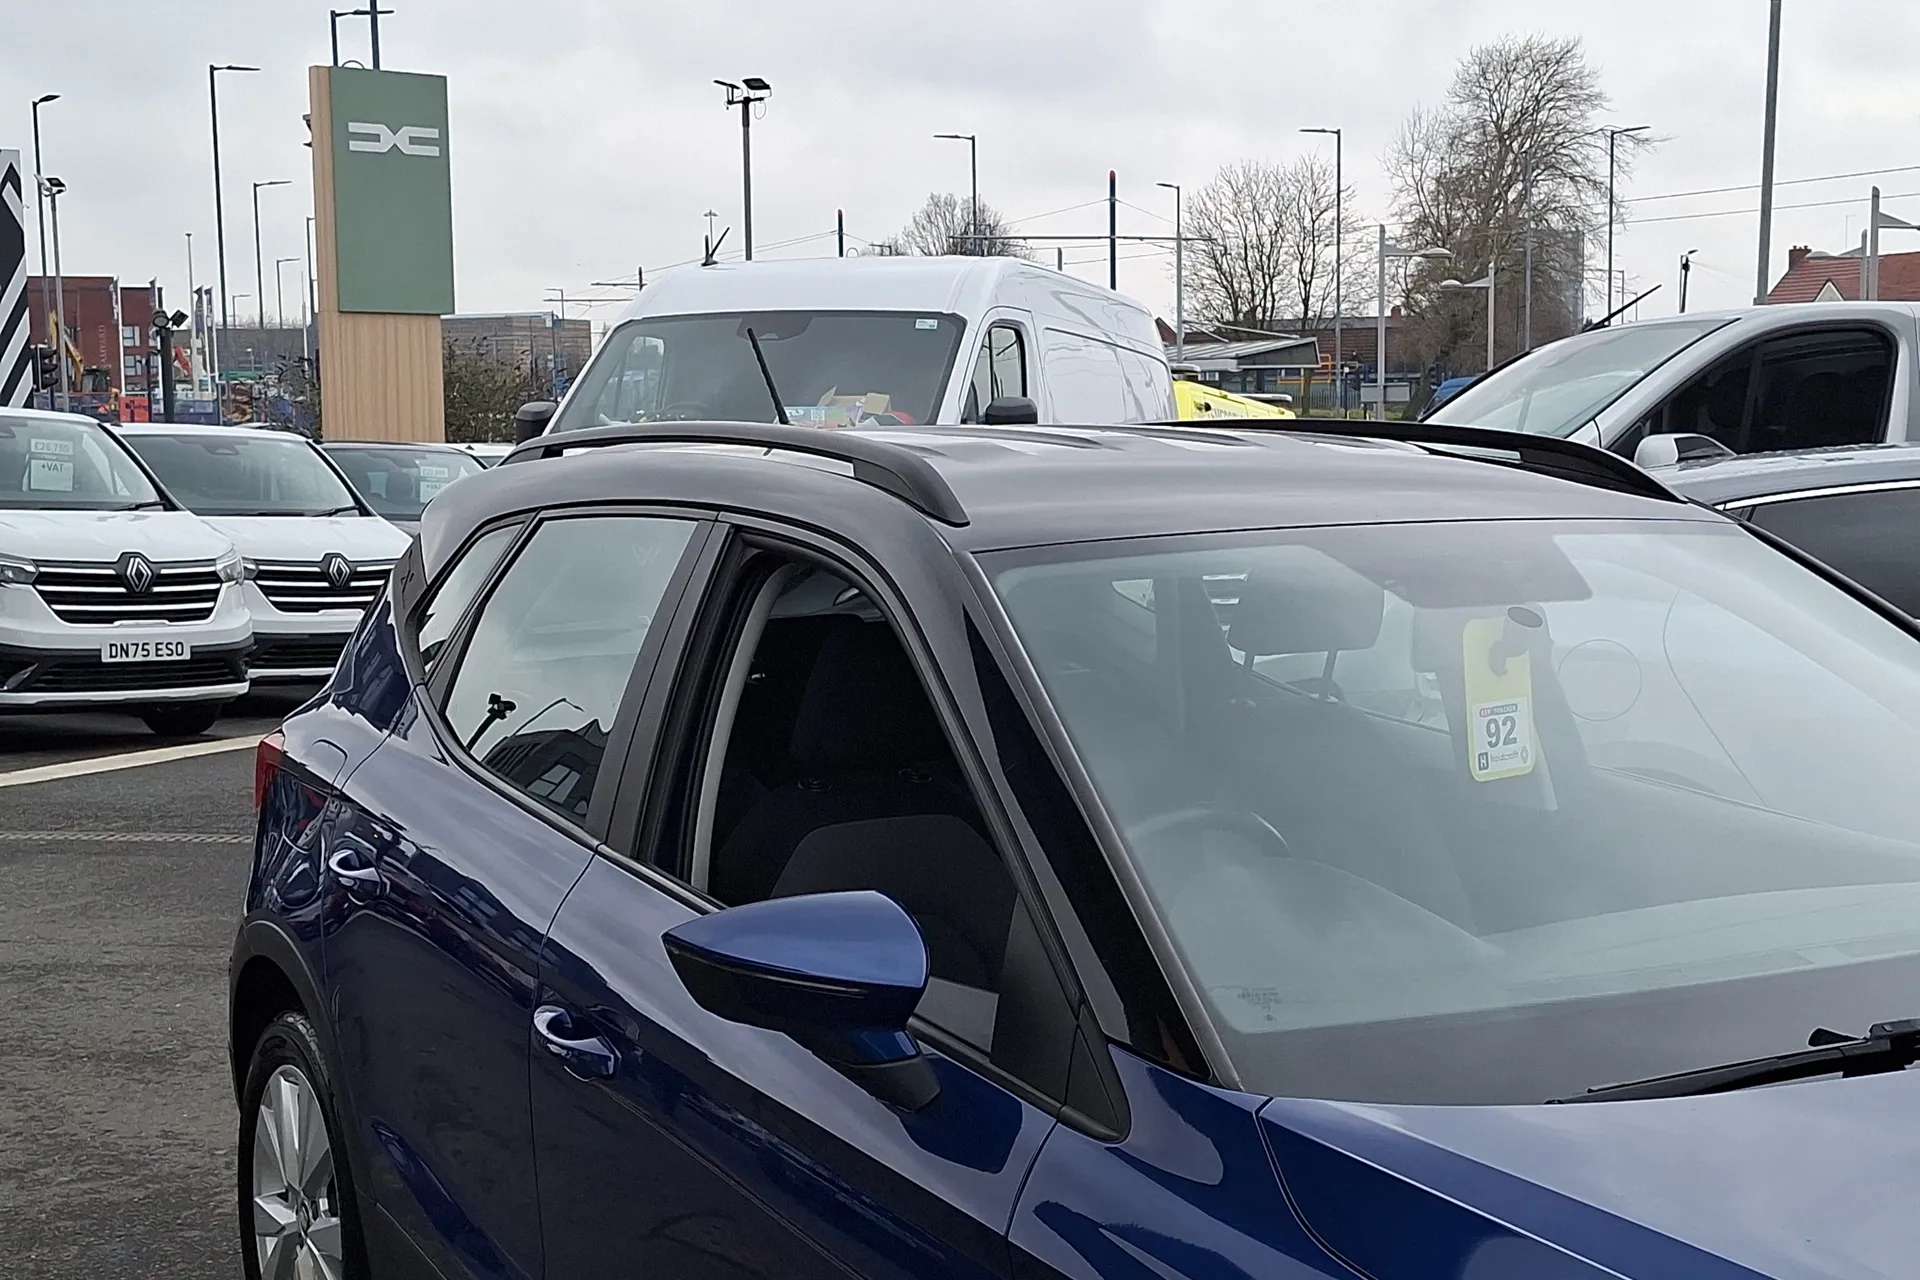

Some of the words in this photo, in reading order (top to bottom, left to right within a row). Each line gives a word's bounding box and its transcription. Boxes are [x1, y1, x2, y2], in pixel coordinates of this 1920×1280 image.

[41, 461, 65, 472] +VAT
[109, 643, 150, 659] DN75
[155, 641, 184, 657] ESO
[1486, 715, 1518, 748] 92
